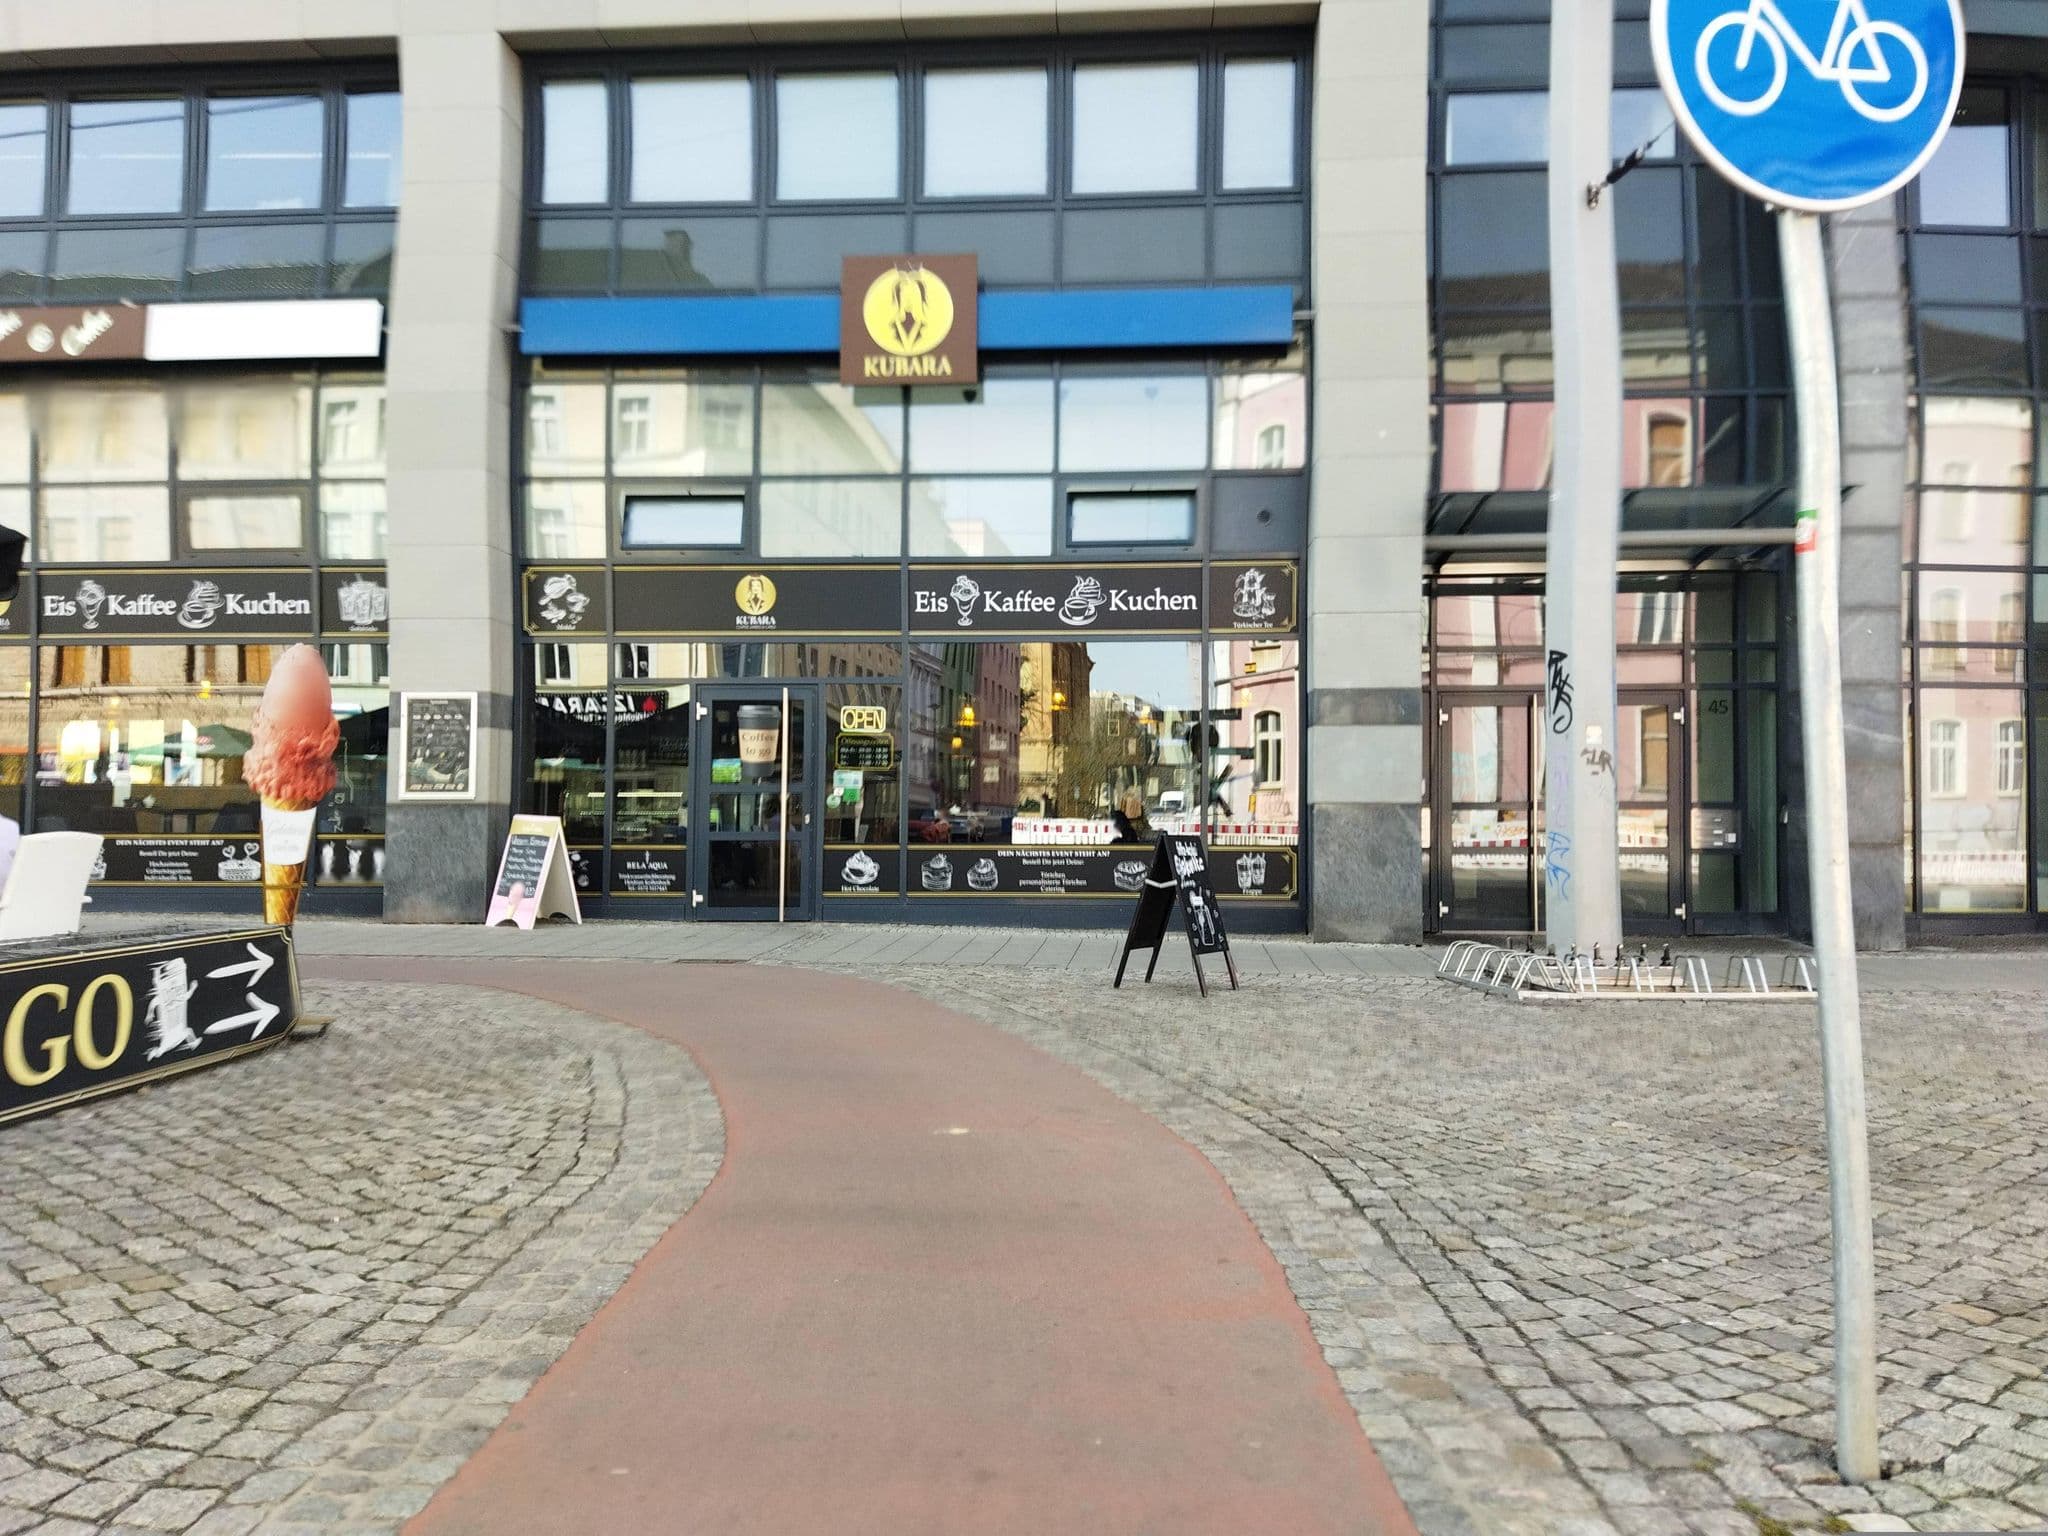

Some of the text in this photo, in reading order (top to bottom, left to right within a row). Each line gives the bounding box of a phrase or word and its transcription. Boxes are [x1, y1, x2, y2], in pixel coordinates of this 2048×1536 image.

[863, 355, 953, 378] KUBARA
[42, 592, 312, 617] Eis Kaffee Kuchen
[914, 590, 1198, 613] Eis Kaffee Kuchen
[1708, 699, 1729, 714] 45
[842, 709, 884, 729] OPEN
[742, 732, 776, 743] Coffee
[746, 746, 772, 758] to go
[1015, 849, 1051, 857] NÄCHSTES
[626, 861, 668, 871] BELA AQUA
[3, 974, 134, 1087] GO
